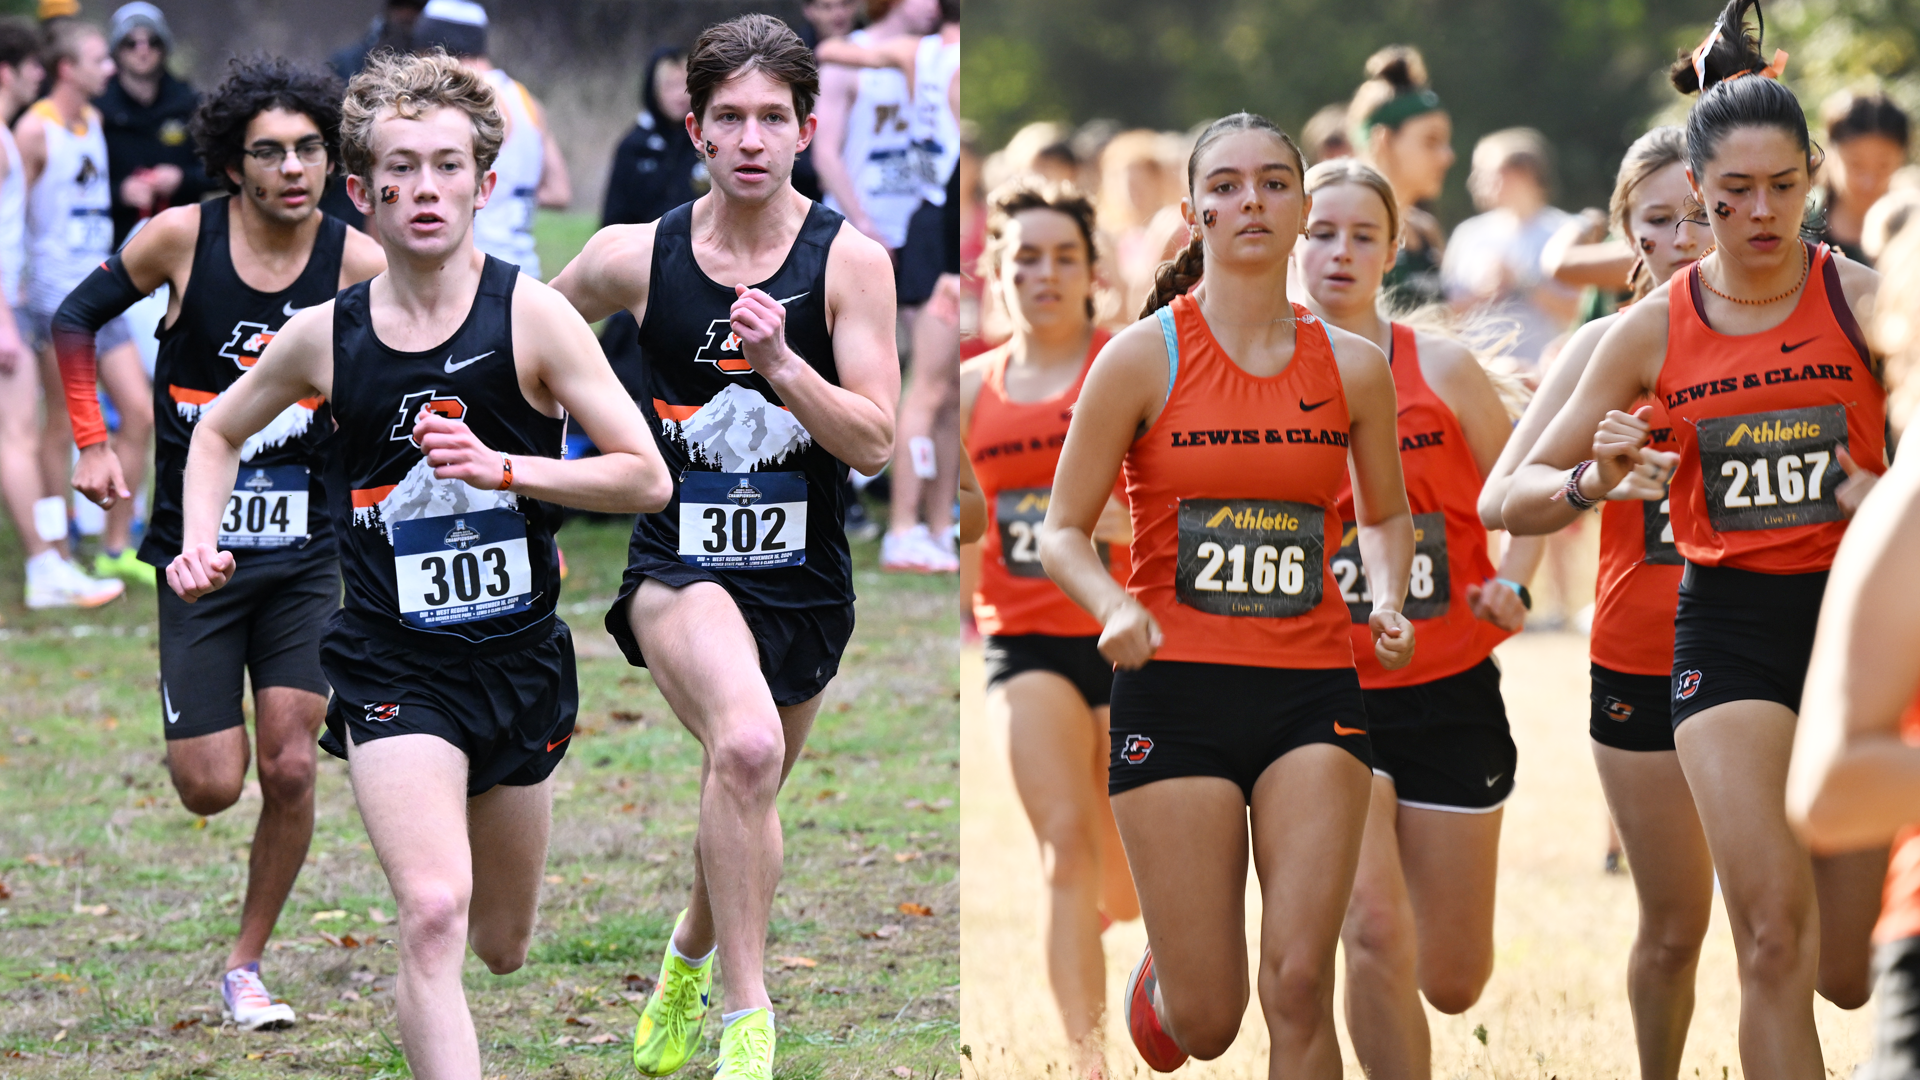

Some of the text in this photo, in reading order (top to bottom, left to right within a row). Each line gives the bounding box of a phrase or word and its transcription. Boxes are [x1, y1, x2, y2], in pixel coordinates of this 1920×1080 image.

[1667, 364, 1853, 410] LEWIS & CLARK
[1171, 429, 1260, 447] LEWIS
[1265, 429, 1284, 444] &
[1399, 430, 1445, 452] ARK
[1721, 450, 1831, 509] 2167
[222, 495, 290, 533] 304
[702, 507, 786, 553] 302
[421, 547, 511, 606] 303
[1194, 541, 1305, 595] 2166
